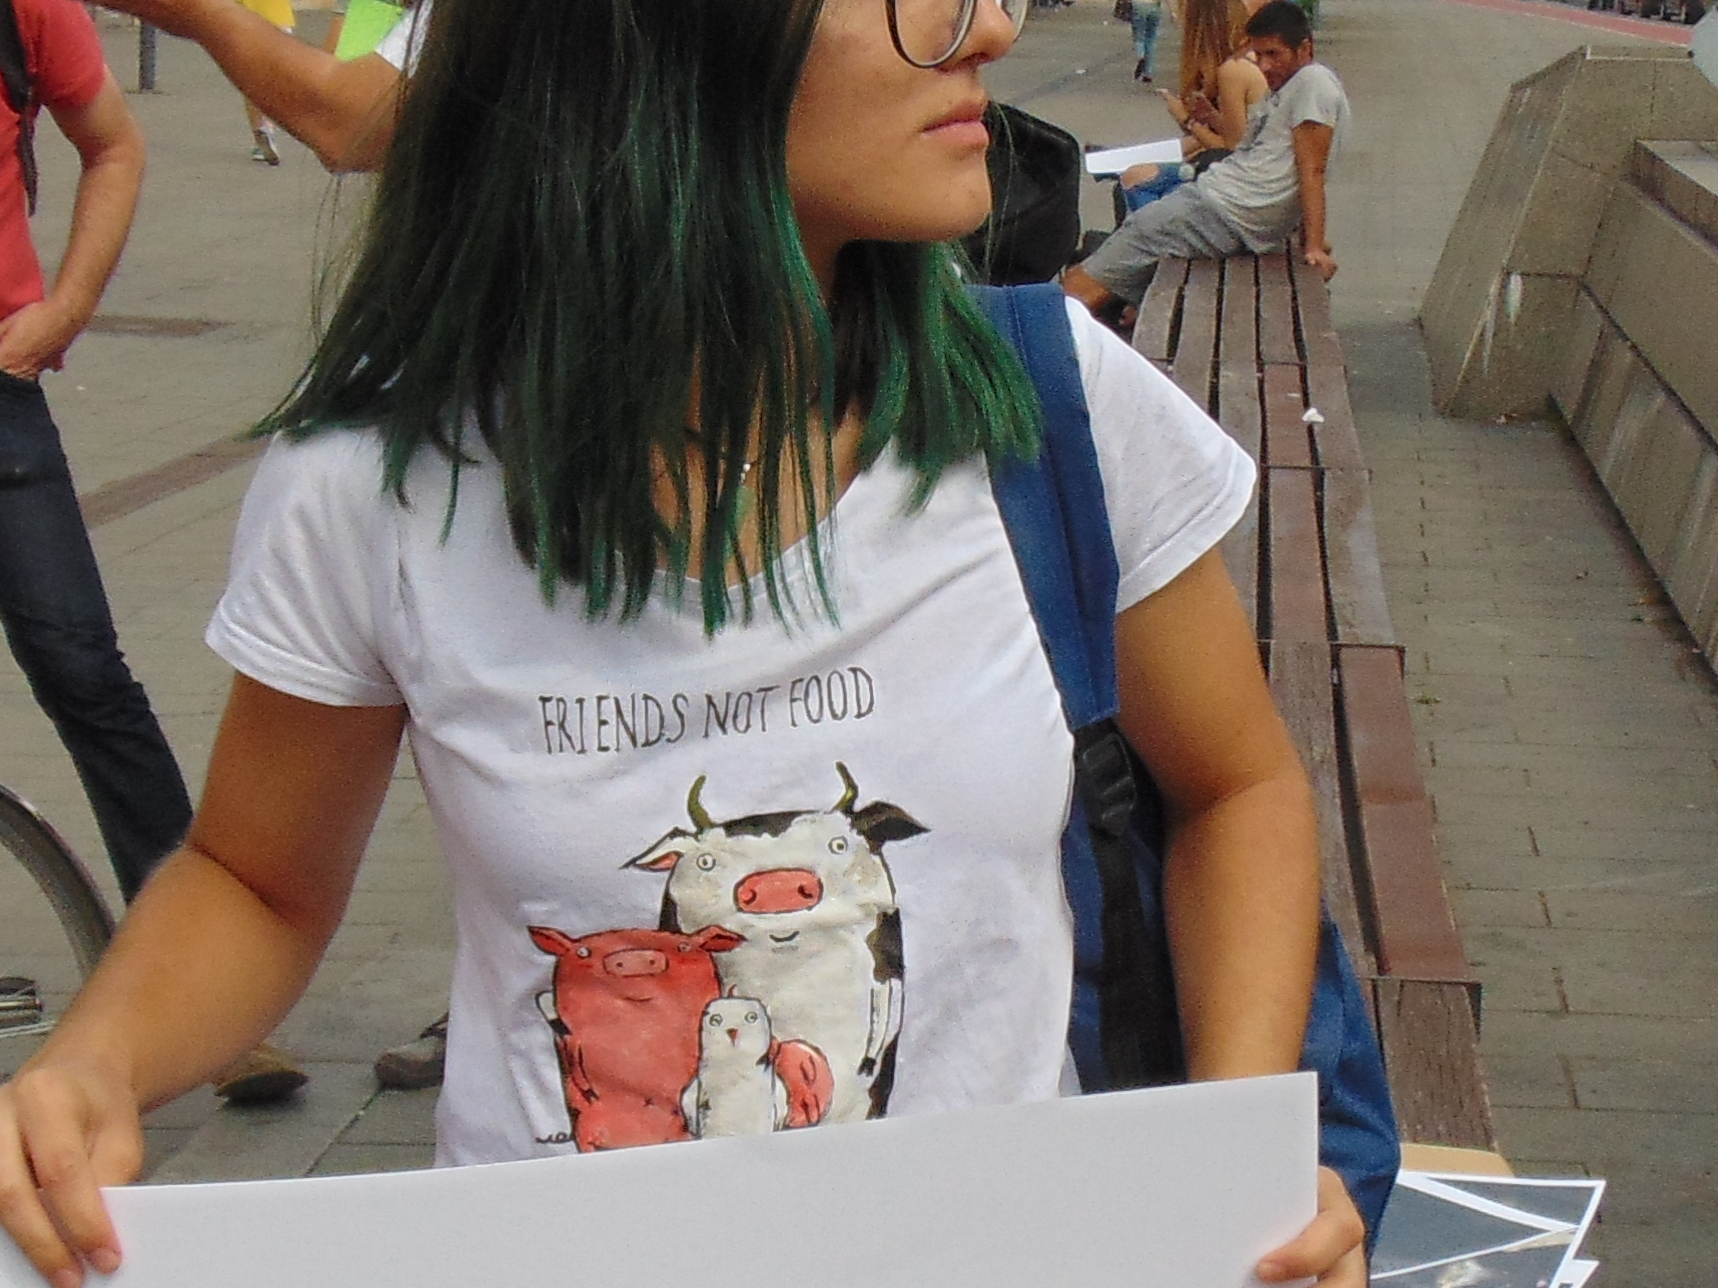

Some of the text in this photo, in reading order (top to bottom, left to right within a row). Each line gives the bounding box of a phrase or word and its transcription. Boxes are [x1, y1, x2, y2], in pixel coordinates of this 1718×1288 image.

[538, 666, 876, 755] FRIENDS NOT FOOD
